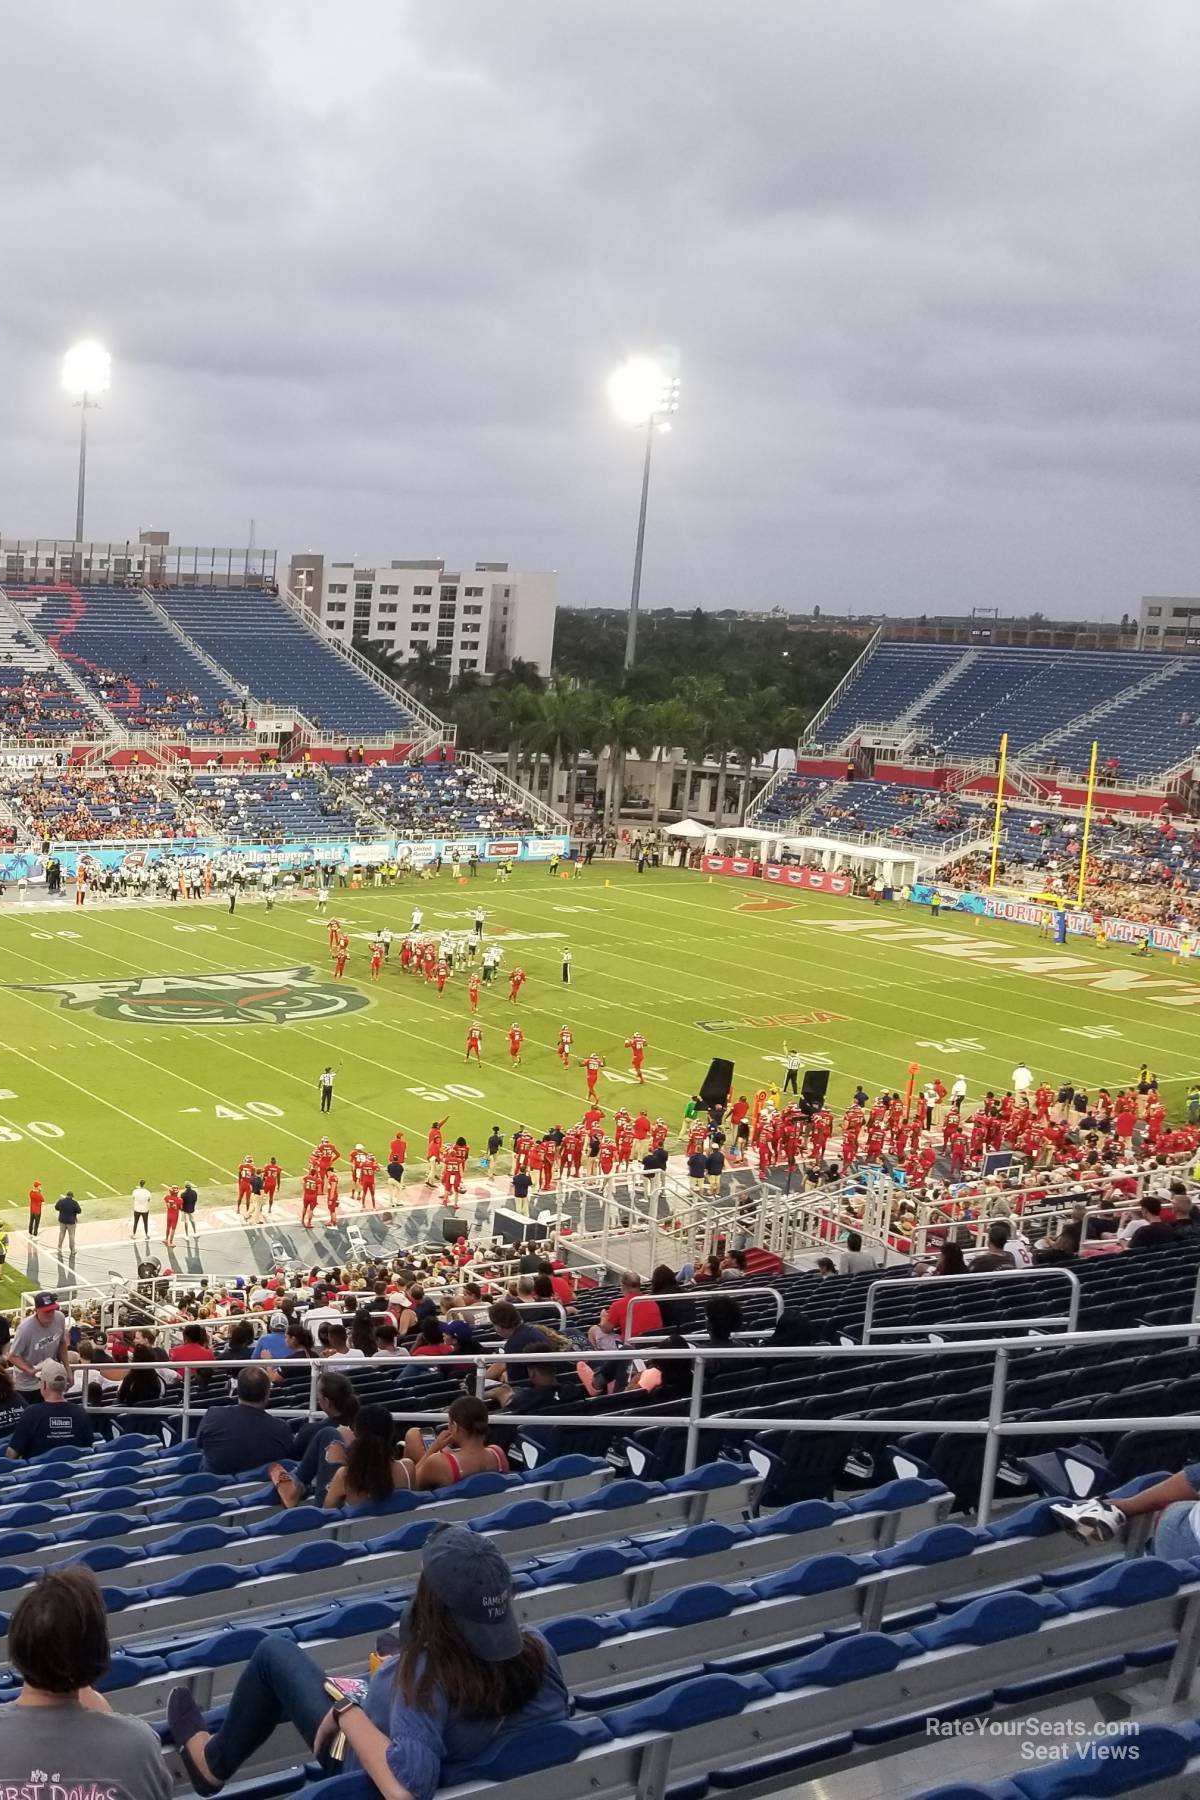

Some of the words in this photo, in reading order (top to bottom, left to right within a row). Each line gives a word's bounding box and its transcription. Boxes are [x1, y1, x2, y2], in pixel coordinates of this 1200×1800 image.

[49, 969, 322, 1004] FAU
[406, 1083, 485, 1102] 50
[215, 1101, 285, 1121] 40
[1018, 1249, 1030, 1264] 8
[52, 1772, 61, 1783] a
